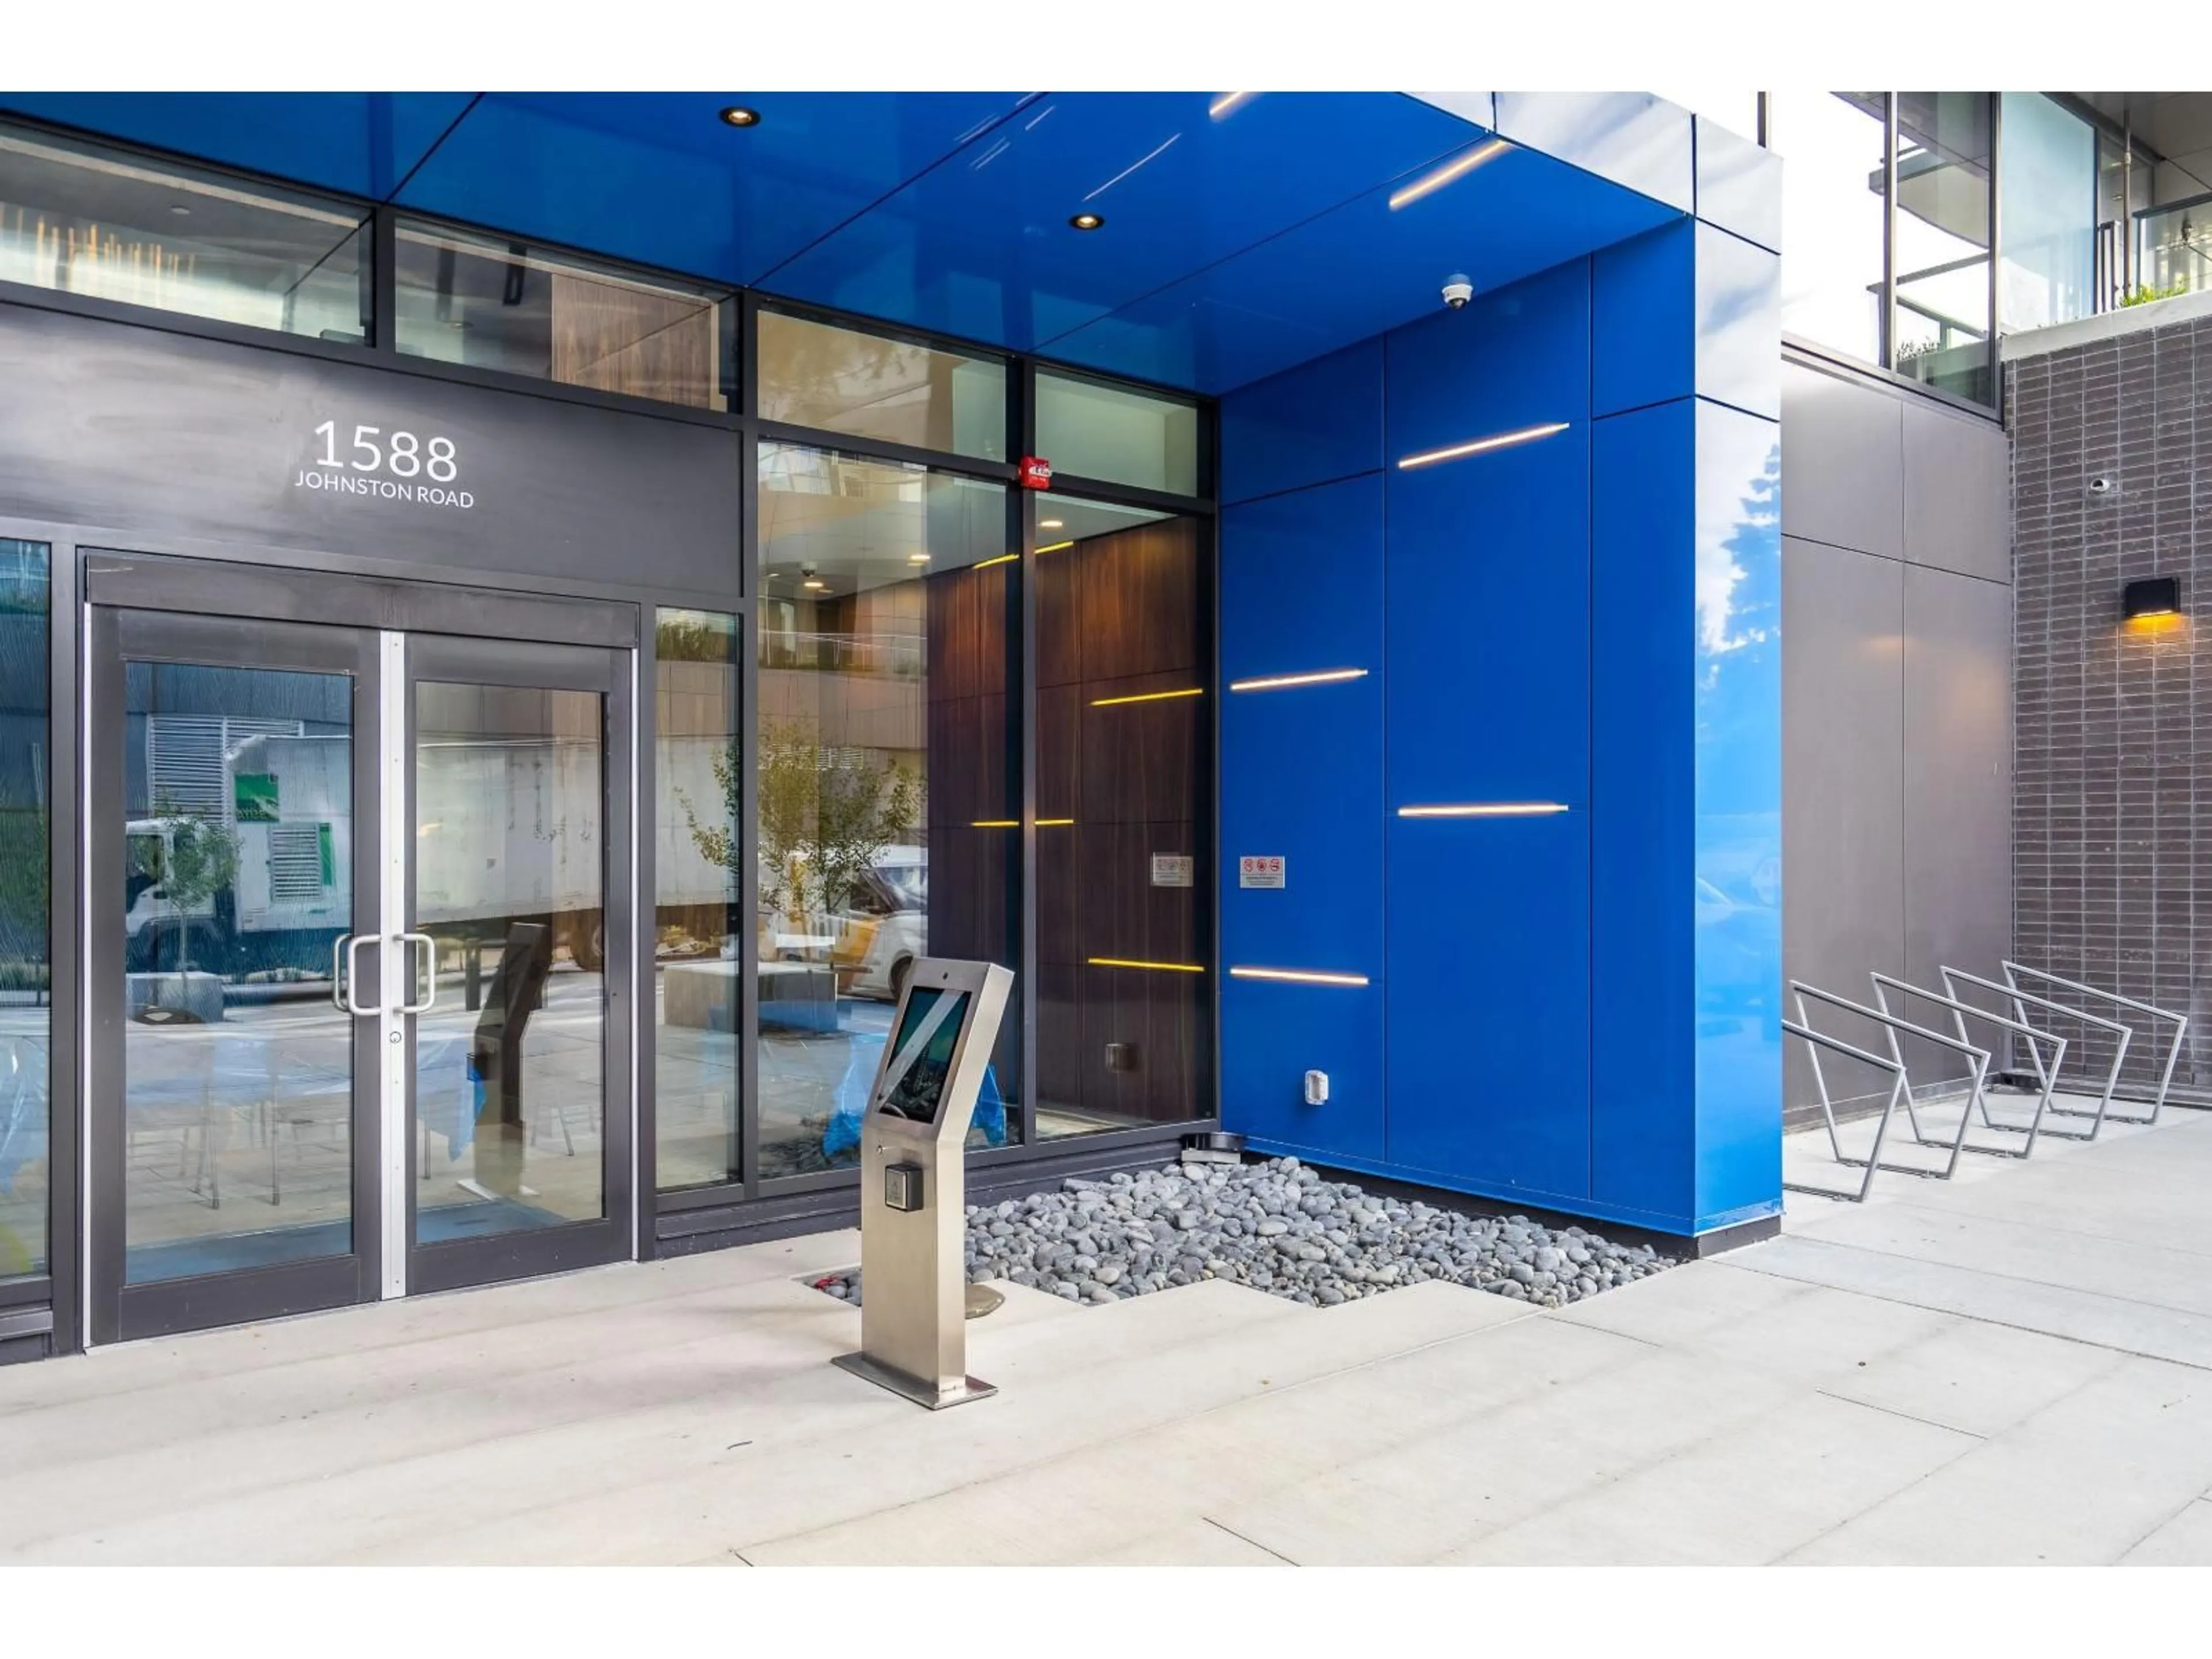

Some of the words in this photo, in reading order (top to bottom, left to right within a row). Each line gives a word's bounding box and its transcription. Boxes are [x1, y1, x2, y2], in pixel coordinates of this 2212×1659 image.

[315, 420, 457, 482] 1588
[294, 470, 412, 501] JOHNSTON
[417, 486, 474, 508] ROAD
